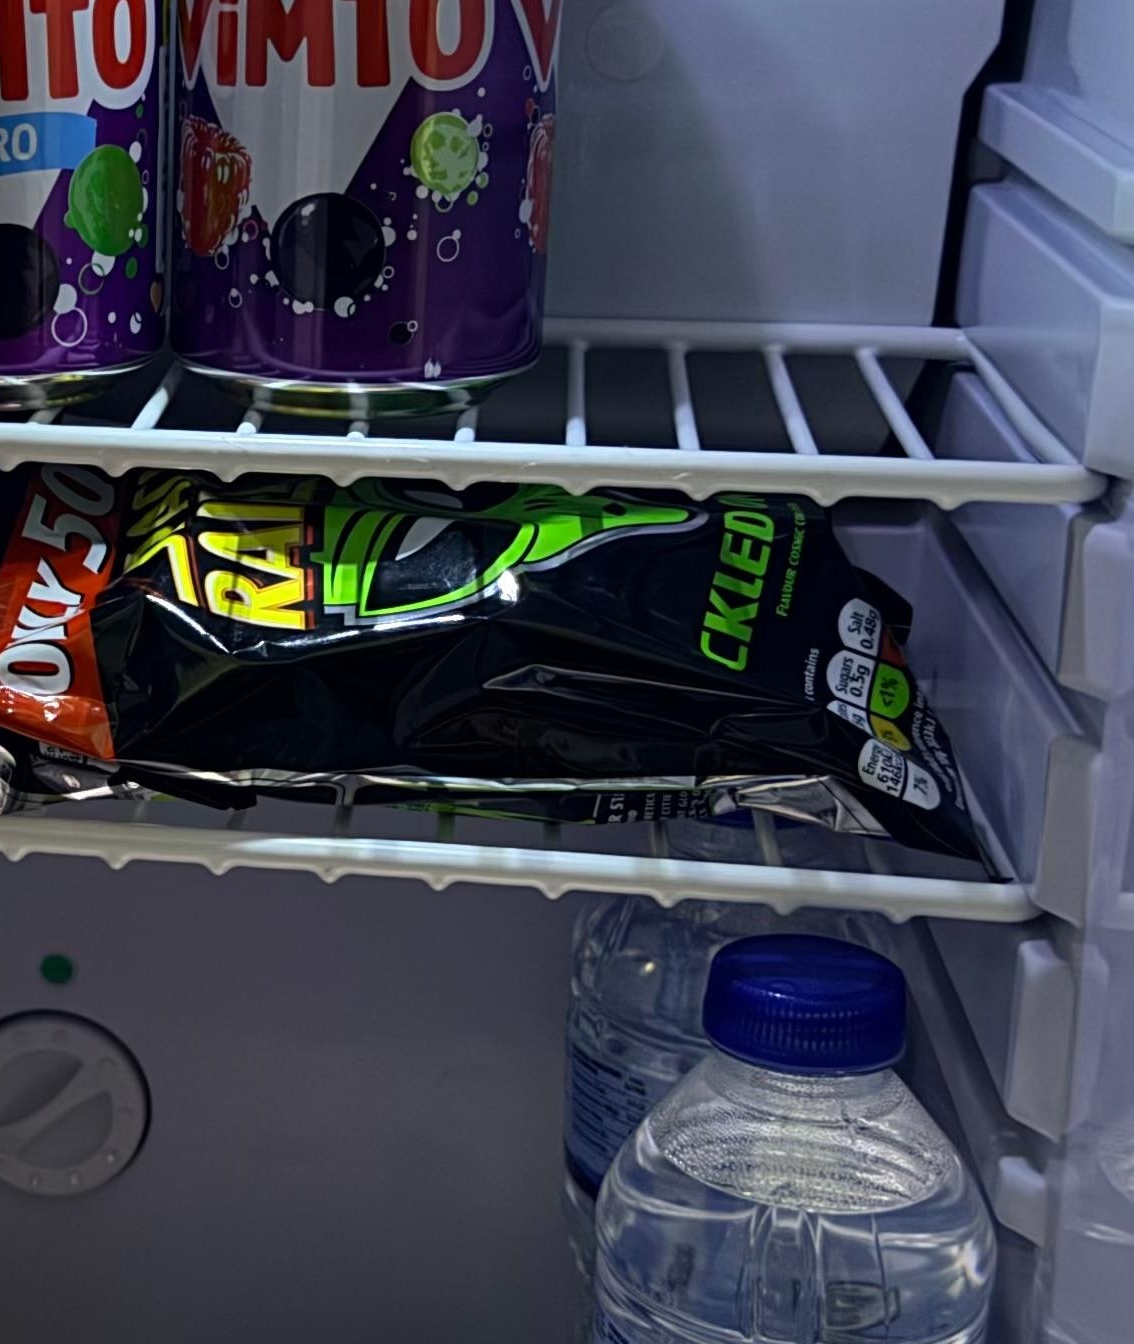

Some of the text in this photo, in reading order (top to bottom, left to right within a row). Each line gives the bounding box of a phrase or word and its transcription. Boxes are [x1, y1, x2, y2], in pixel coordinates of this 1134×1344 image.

[848, 611, 865, 635] Salt
[860, 609, 880, 649] 0.48g
[835, 656, 854, 695] Sugars
[851, 664, 870, 697] 0.5g
